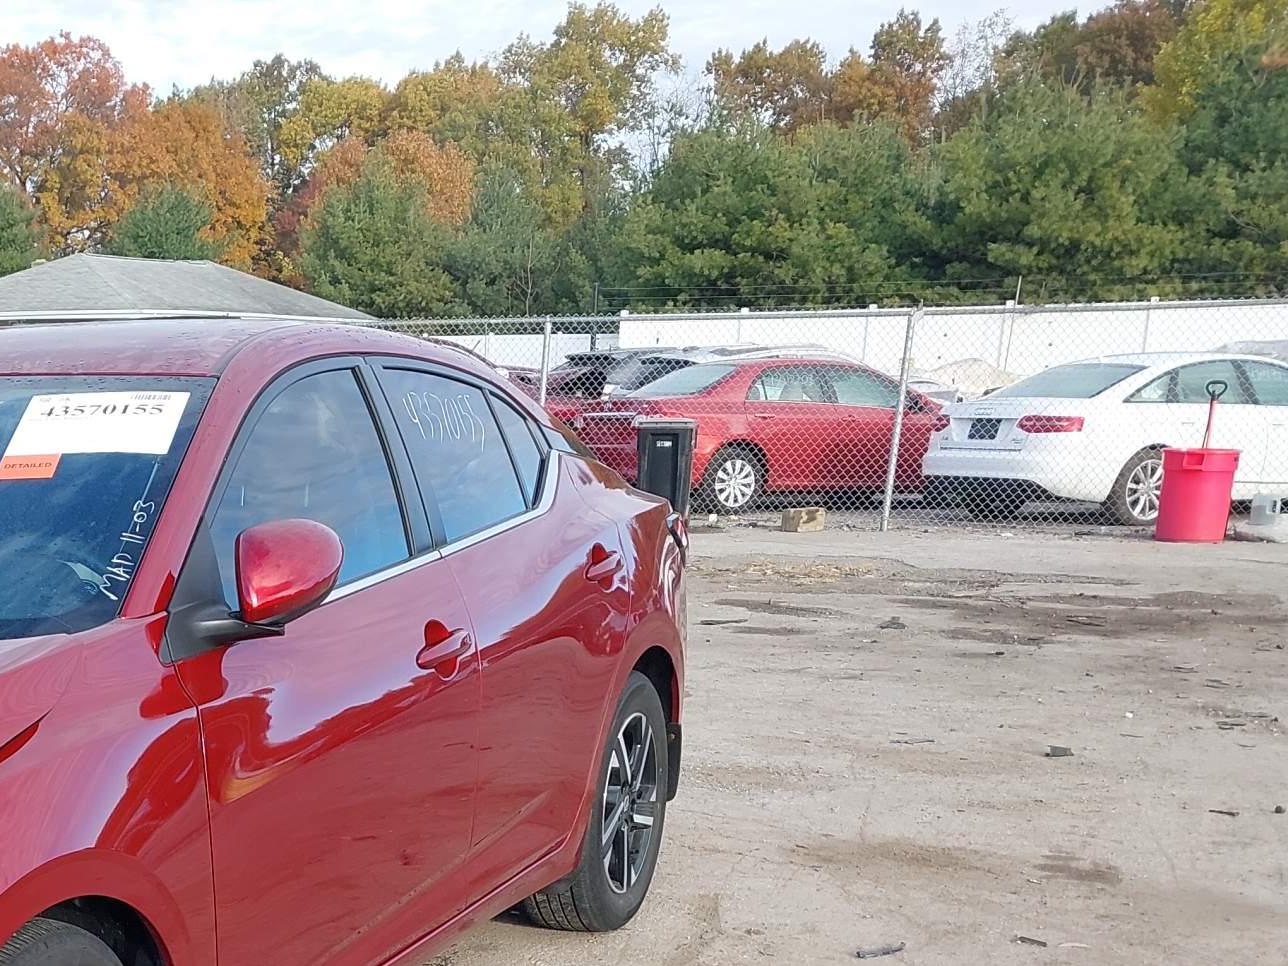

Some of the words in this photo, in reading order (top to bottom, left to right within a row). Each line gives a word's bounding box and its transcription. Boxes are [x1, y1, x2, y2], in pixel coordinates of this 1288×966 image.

[40, 403, 165, 417] 43570155
[3, 461, 53, 469] DETAILED
[99, 553, 135, 601] MAD
[119, 500, 155, 544] 11-03
